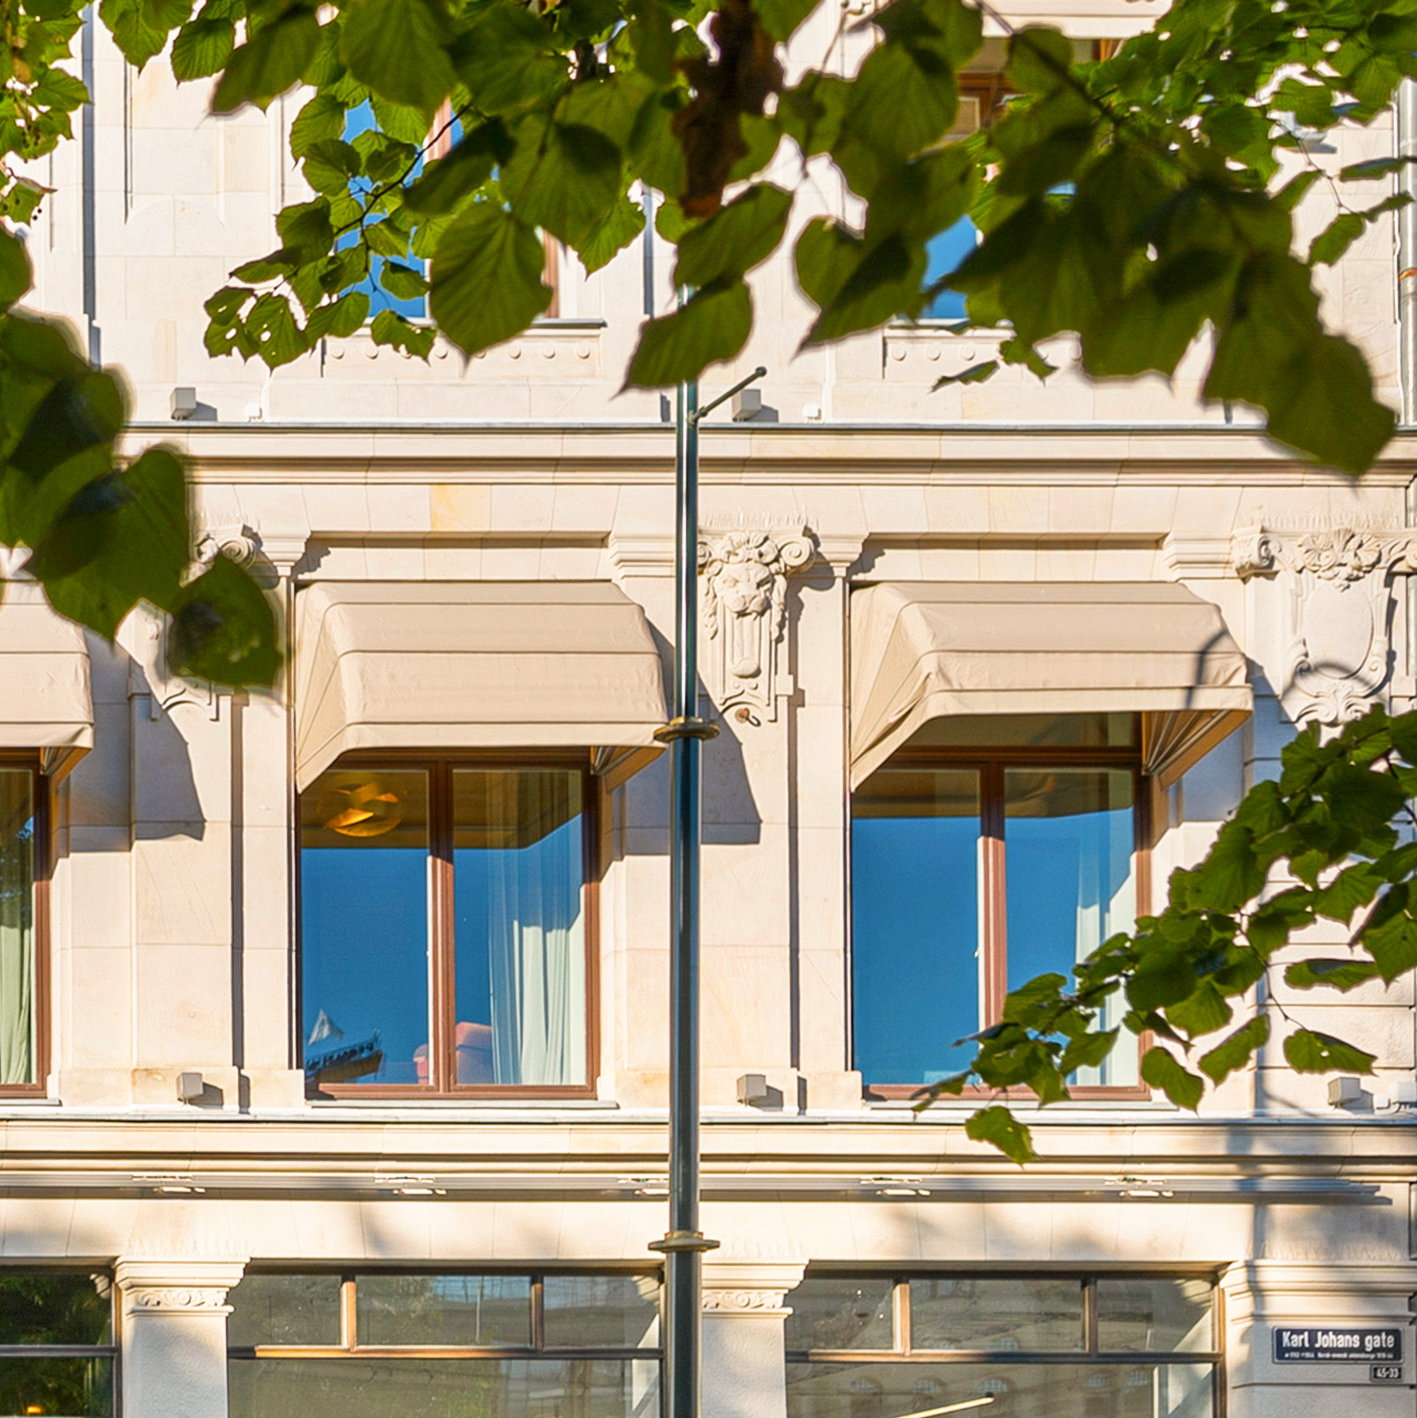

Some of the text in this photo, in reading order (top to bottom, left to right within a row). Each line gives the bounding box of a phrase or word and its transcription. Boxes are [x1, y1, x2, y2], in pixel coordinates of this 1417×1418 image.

[1282, 1331, 1395, 1352] Karl Johans gate
